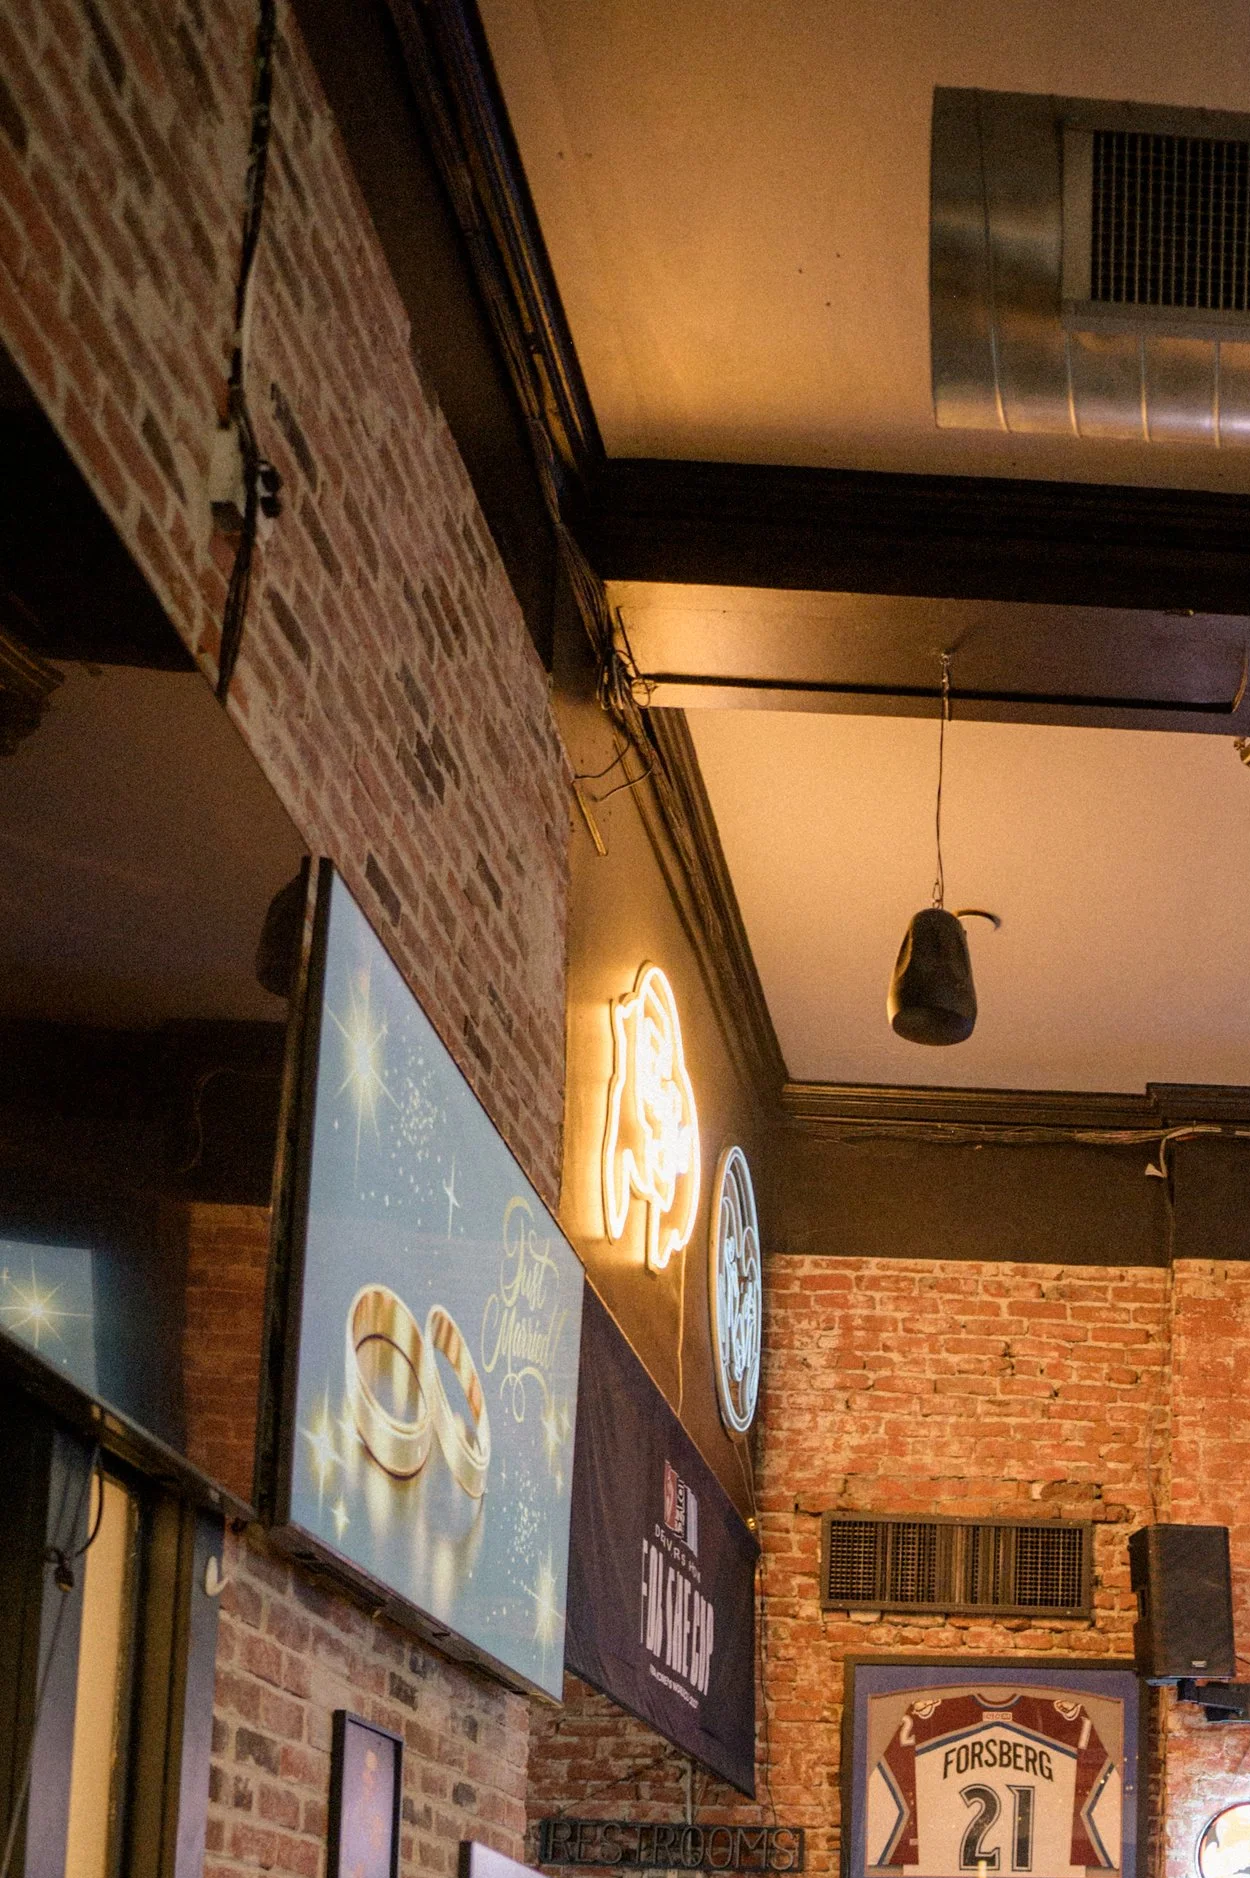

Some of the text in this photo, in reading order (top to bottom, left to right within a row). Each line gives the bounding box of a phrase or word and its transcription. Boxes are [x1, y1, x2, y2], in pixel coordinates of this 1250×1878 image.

[502, 1196, 560, 1311] Just
[943, 1739, 1053, 1782] FORSBERG
[549, 1821, 796, 1871] RESTROOMS
[959, 1783, 1036, 1872] 21
